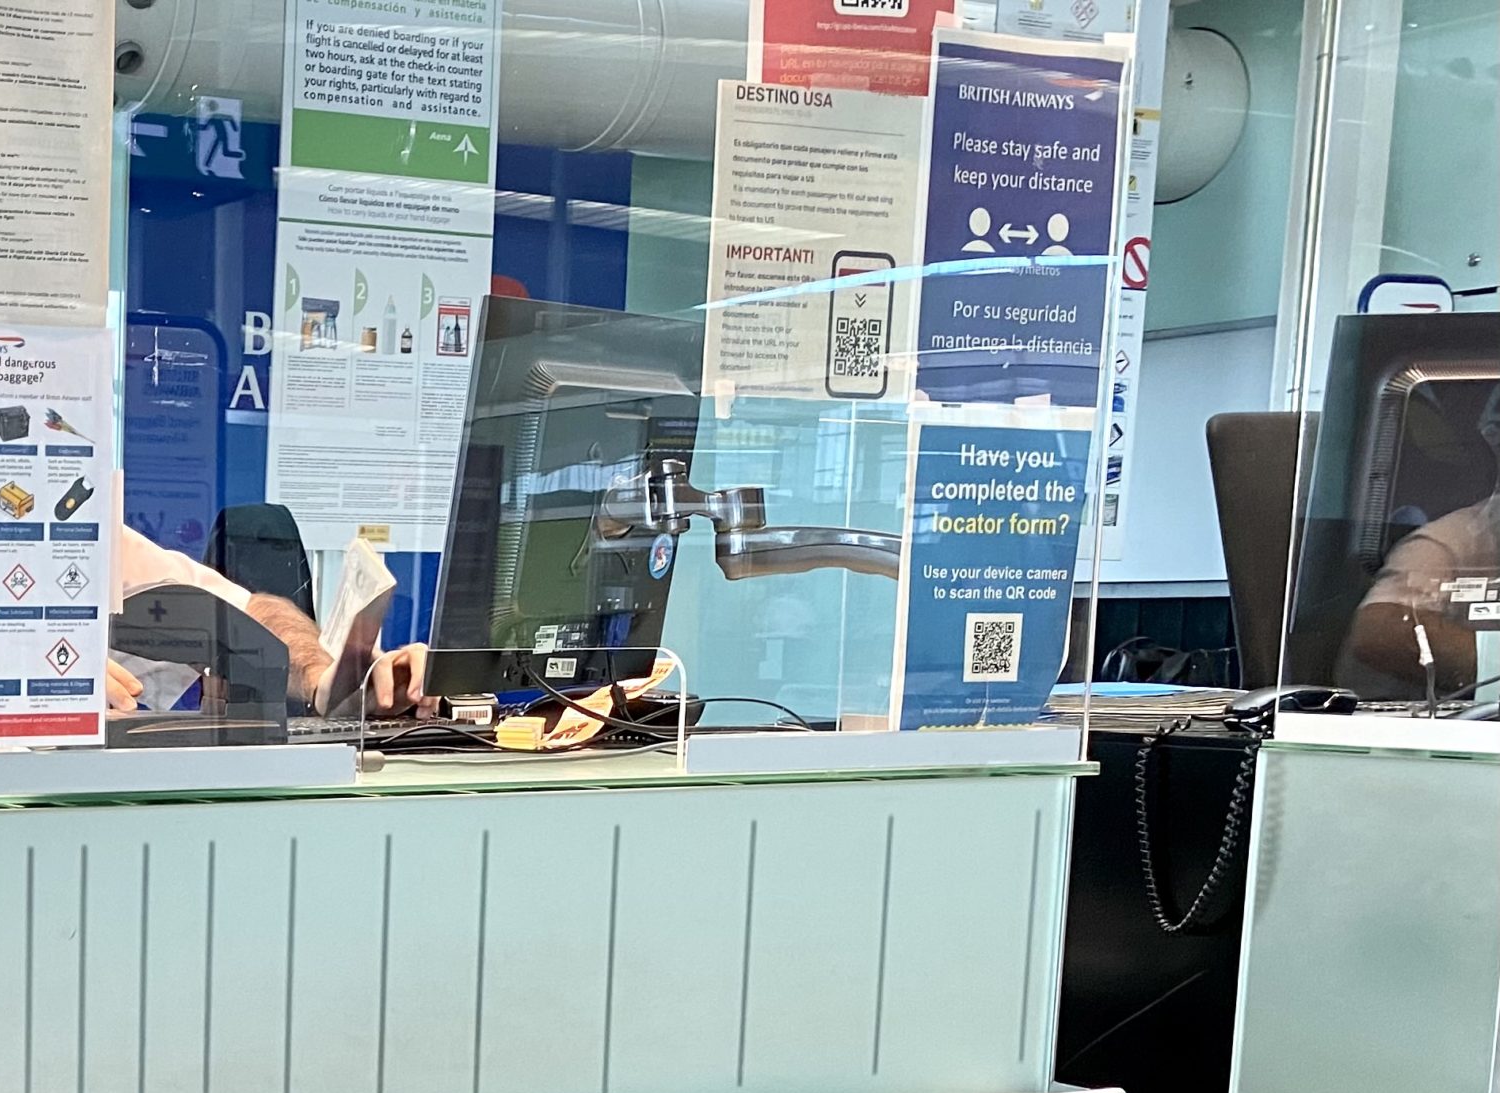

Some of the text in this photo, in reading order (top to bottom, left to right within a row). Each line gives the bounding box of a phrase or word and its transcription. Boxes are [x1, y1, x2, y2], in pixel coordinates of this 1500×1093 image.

[306, 19, 484, 51] If you are denied boarding or if your
[306, 33, 483, 64] flight is cancelled or delayed for at least
[305, 49, 483, 76] two hours, ask at the check-in counter
[305, 62, 482, 93] or boarding gate for the text stating
[304, 78, 481, 104] your rights, particularly with regard to
[304, 91, 480, 117] compensation and assistance.
[737, 85, 833, 108] DESTINO USA
[959, 84, 1074, 110] BRITISH AIRWAYS
[429, 132, 451, 141] Aena
[954, 132, 1100, 162] Please stay safe and
[954, 165, 1093, 193] keep your distance
[953, 300, 1077, 325] Por su seguridad
[931, 334, 1092, 355] mantenga la distancia
[5, 356, 56, 370] dangerous
[961, 443, 1054, 472] Have you
[931, 479, 1075, 505] completed the
[932, 510, 1070, 535] locator form?
[924, 565, 1067, 582] Use your device camera
[934, 586, 1056, 600] to scan the QR code
